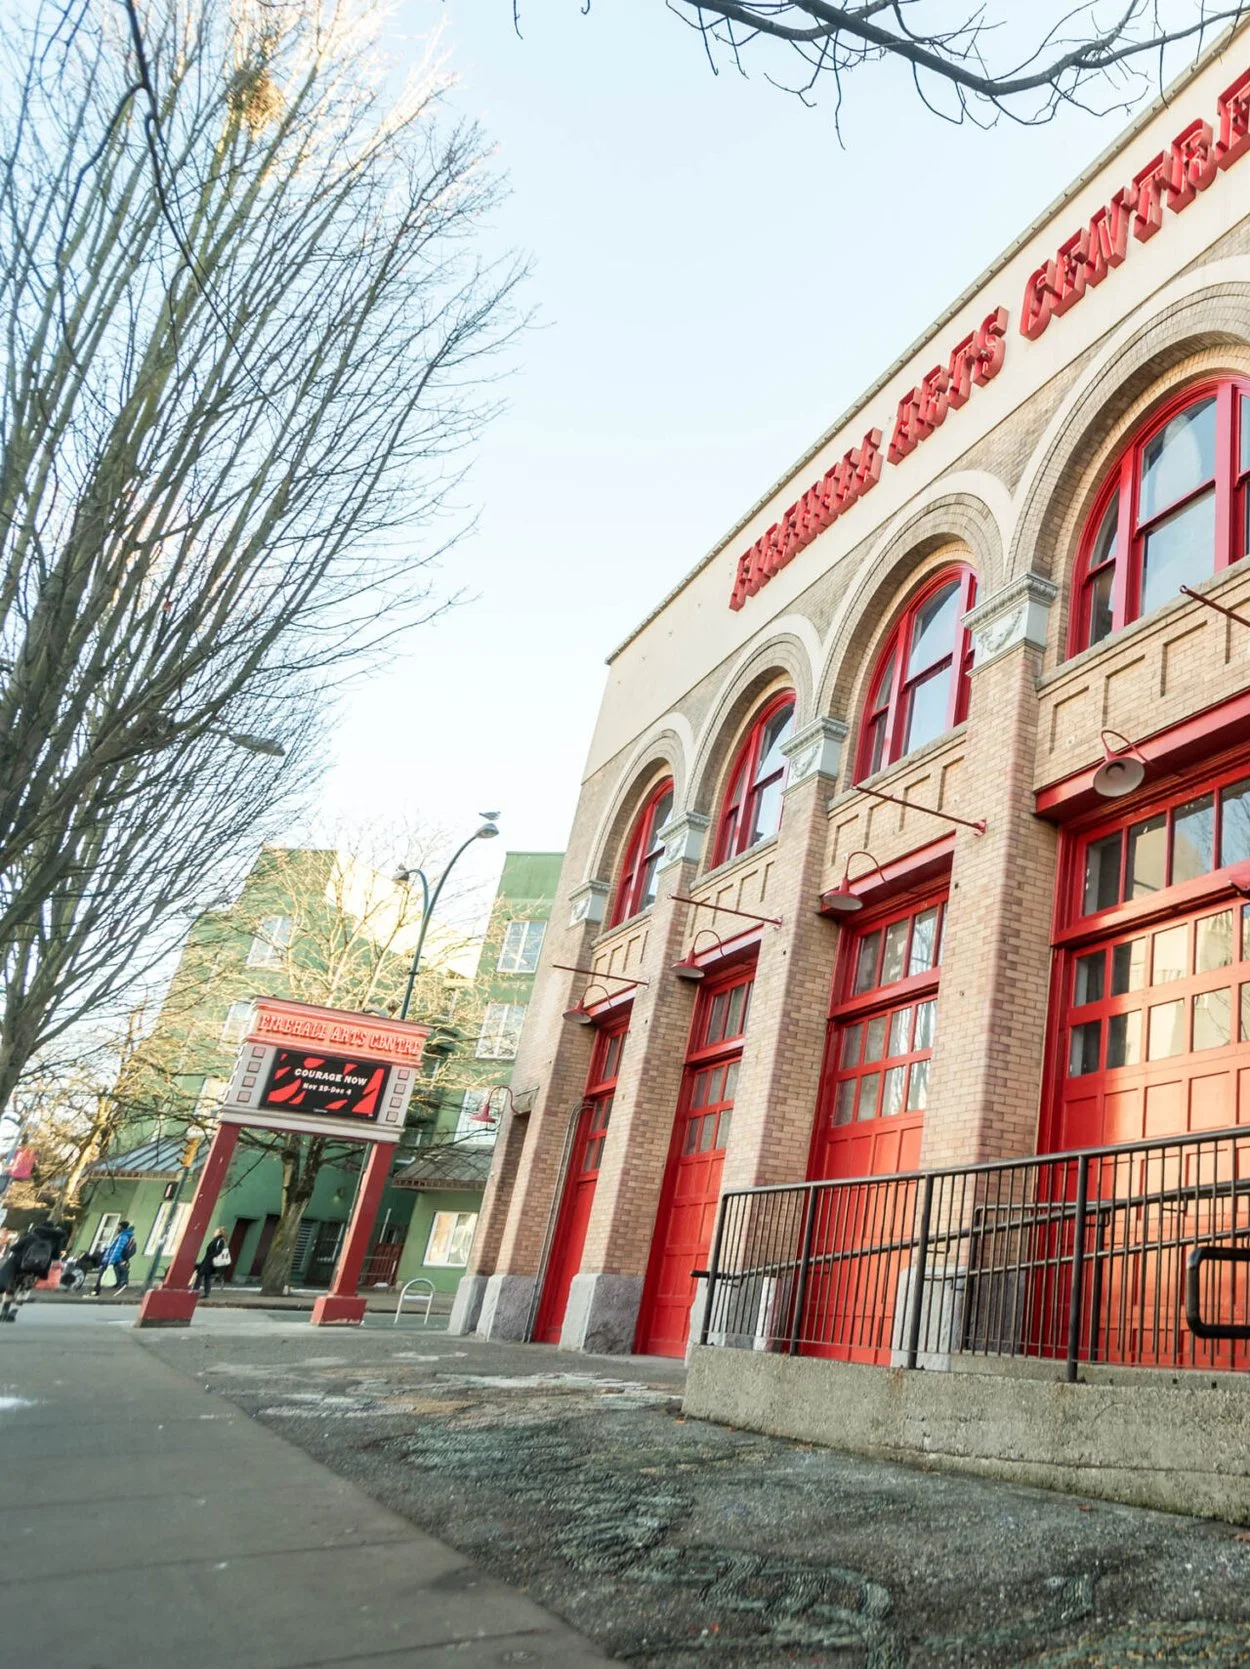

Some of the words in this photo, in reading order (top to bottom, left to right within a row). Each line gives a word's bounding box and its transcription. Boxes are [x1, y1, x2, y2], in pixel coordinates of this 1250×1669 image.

[729, 427, 883, 612] FIREHALL
[887, 305, 1009, 466] ARTS
[258, 1015, 327, 1040] FIREHALL
[330, 1024, 366, 1047] ARTS
[369, 1033, 422, 1056] CENTRE
[294, 1068, 342, 1083] COURAGE
[343, 1075, 368, 1086] NOW
